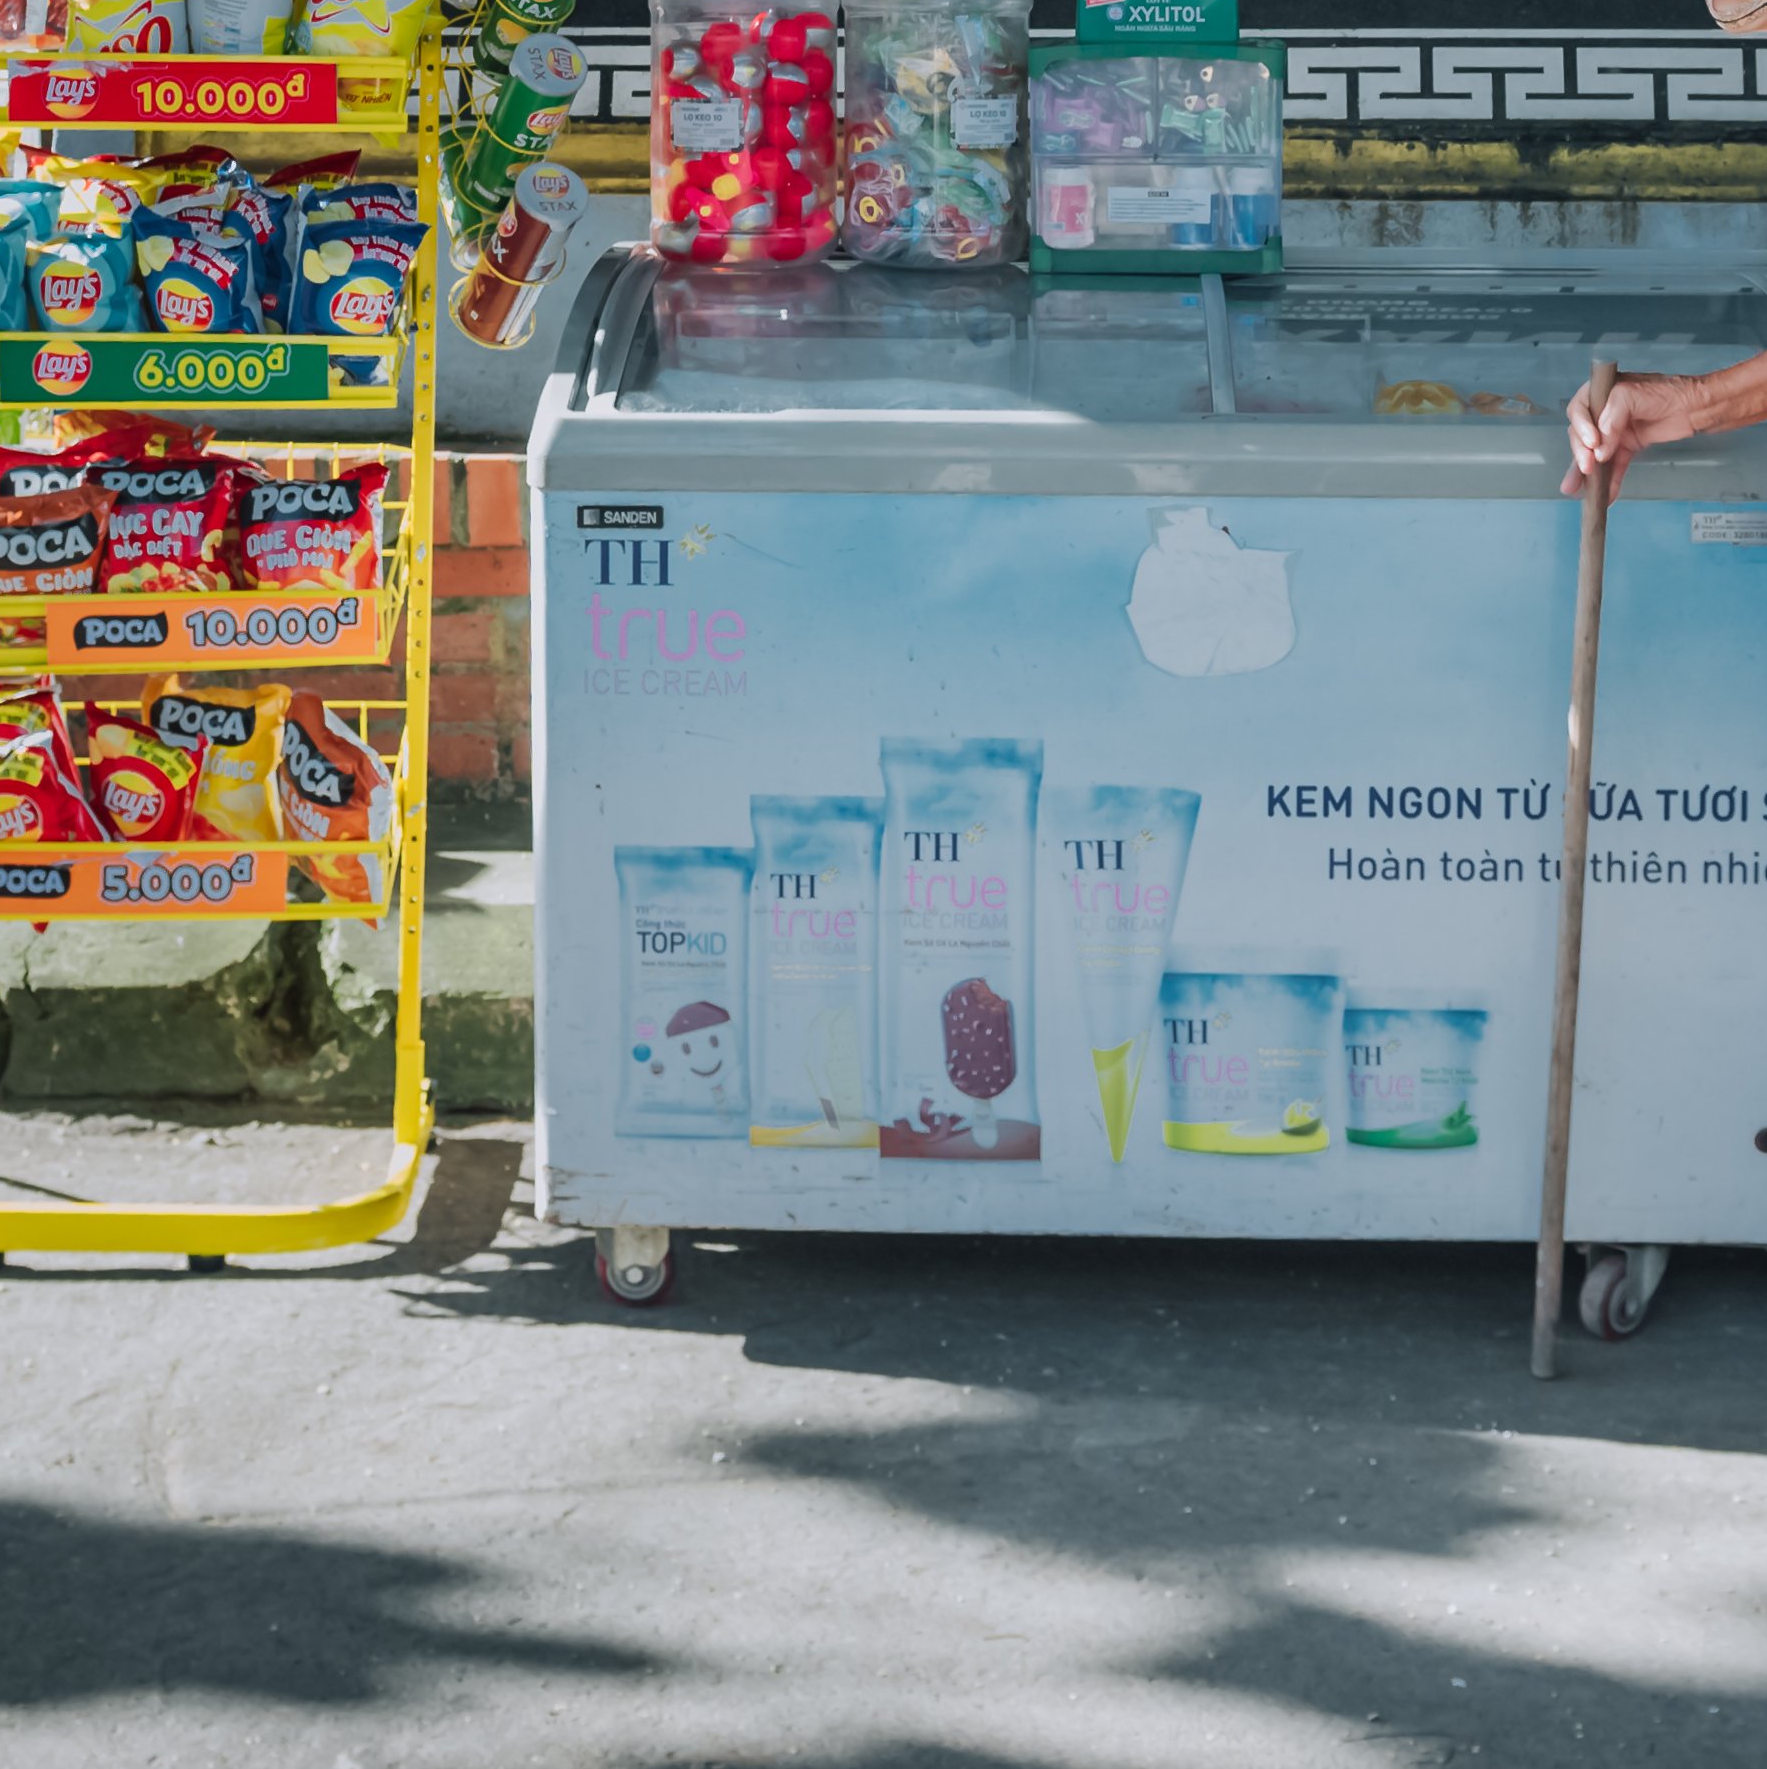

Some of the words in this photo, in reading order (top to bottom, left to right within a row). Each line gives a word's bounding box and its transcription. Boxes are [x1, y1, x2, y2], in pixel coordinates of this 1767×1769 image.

[1128, 5, 1206, 23] XYLITOL
[45, 76, 96, 106] Lay's
[136, 73, 306, 116] 10.000đ
[533, 173, 569, 194] Lay's
[539, 200, 577, 212] STAX
[43, 274, 101, 311] Lay's
[158, 288, 210, 324] Lay's
[334, 291, 394, 322] Lay's
[37, 355, 89, 383] Lay's
[138, 346, 285, 389] 6.000đ
[101, 469, 206, 498] POCA
[250, 484, 354, 521] POCA
[604, 511, 657, 524] SANDEN
[152, 508, 204, 537] CAY
[246, 529, 287, 558] QUE
[584, 539, 675, 586] TH
[83, 616, 164, 646] POCA
[186, 597, 359, 647] 10.000đ
[584, 591, 747, 662] true
[584, 669, 631, 695] ICE
[641, 669, 747, 696] CREAM
[159, 697, 247, 742] POCA
[282, 719, 341, 804] POCA
[104, 781, 161, 823] Lay's
[1267, 785, 1352, 818] KEM
[1368, 786, 1482, 820] NGON
[1496, 778, 1551, 820] TỪ
[1589, 781, 1644, 821] ỮA
[1656, 784, 1749, 822] TƯƠI
[904, 831, 962, 862] TH
[1064, 839, 1127, 870] TH
[101, 854, 254, 902] 5.000đ
[1328, 847, 1426, 881] Hoàn
[1439, 848, 1524, 883] toàn
[1590, 850, 1687, 883] thiên
[770, 873, 818, 899] TH
[905, 865, 1008, 910] true
[1070, 873, 1171, 915] true
[772, 901, 857, 939] true
[636, 931, 728, 956] TOPKID
[1163, 1017, 1210, 1045] TH
[1167, 1046, 1250, 1086] true
[1345, 1045, 1382, 1066] TH
[1349, 1067, 1415, 1098] true
